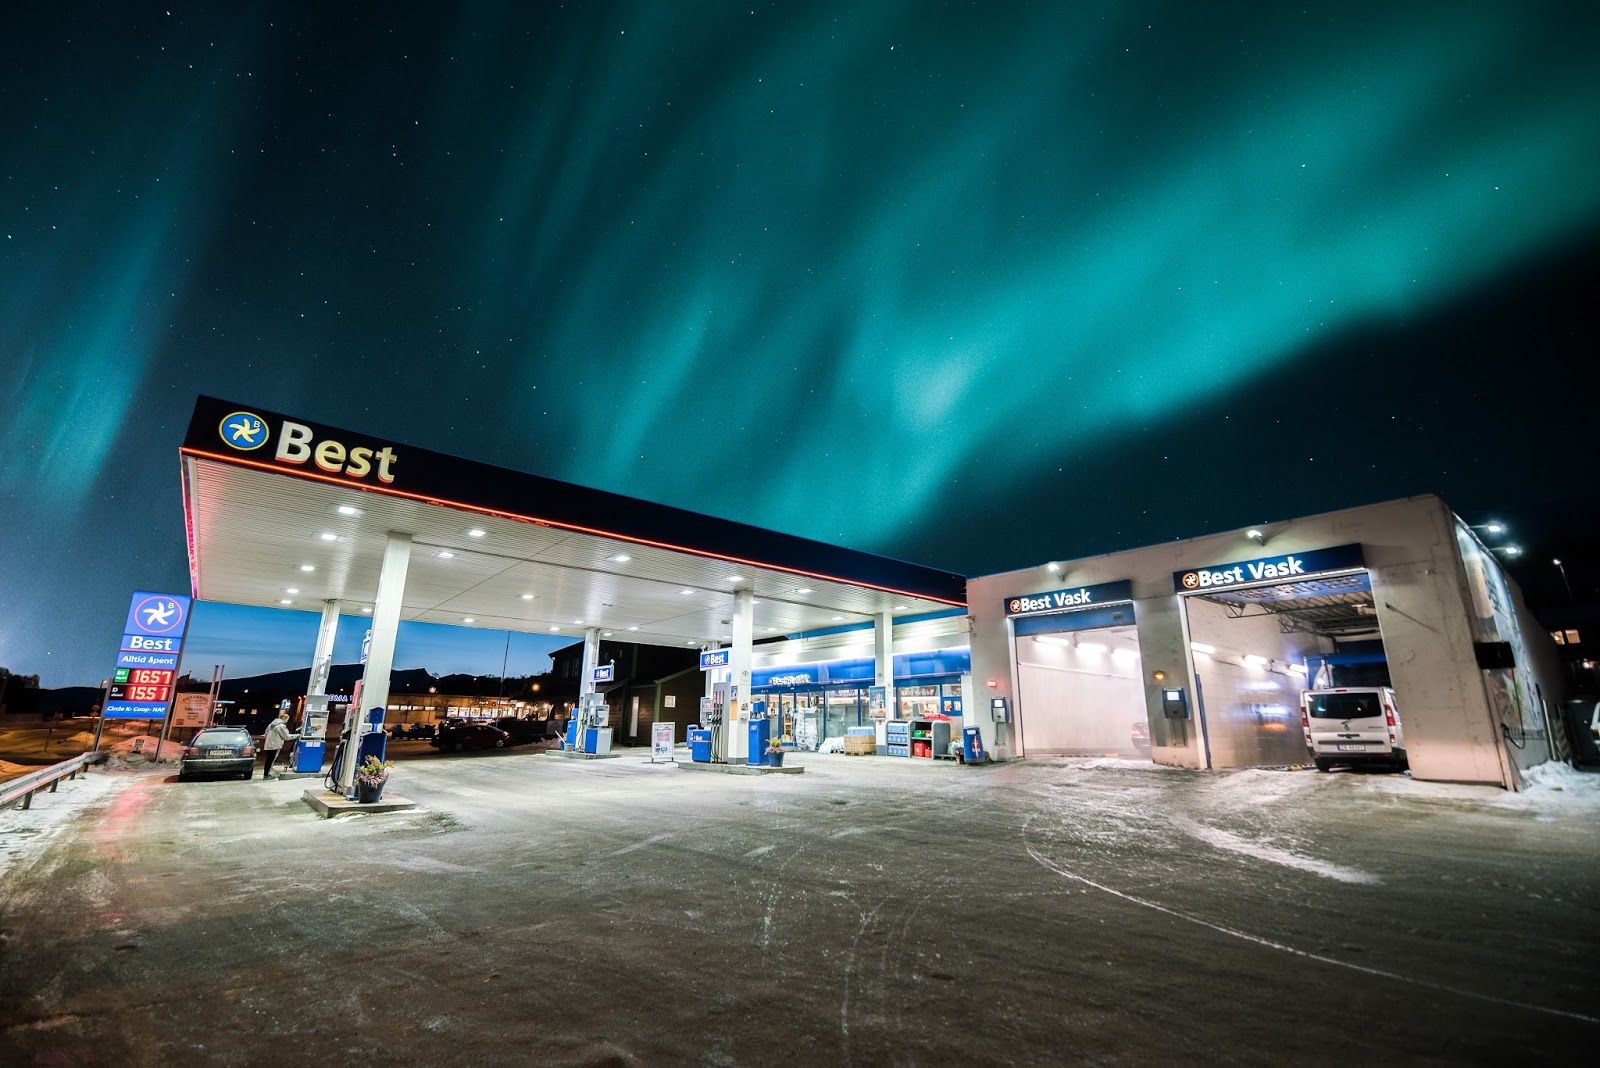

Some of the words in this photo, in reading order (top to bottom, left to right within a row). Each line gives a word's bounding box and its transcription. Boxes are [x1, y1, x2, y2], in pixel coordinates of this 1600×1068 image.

[275, 420, 398, 484] Best
[1199, 566, 1245, 587] Best
[1247, 556, 1305, 580] Vask
[1020, 595, 1052, 612] Best
[1054, 588, 1092, 607] Vask
[130, 635, 172, 651] Best
[122, 655, 146, 664] Alltid
[147, 655, 174, 665] åpent
[710, 652, 724, 665] Best
